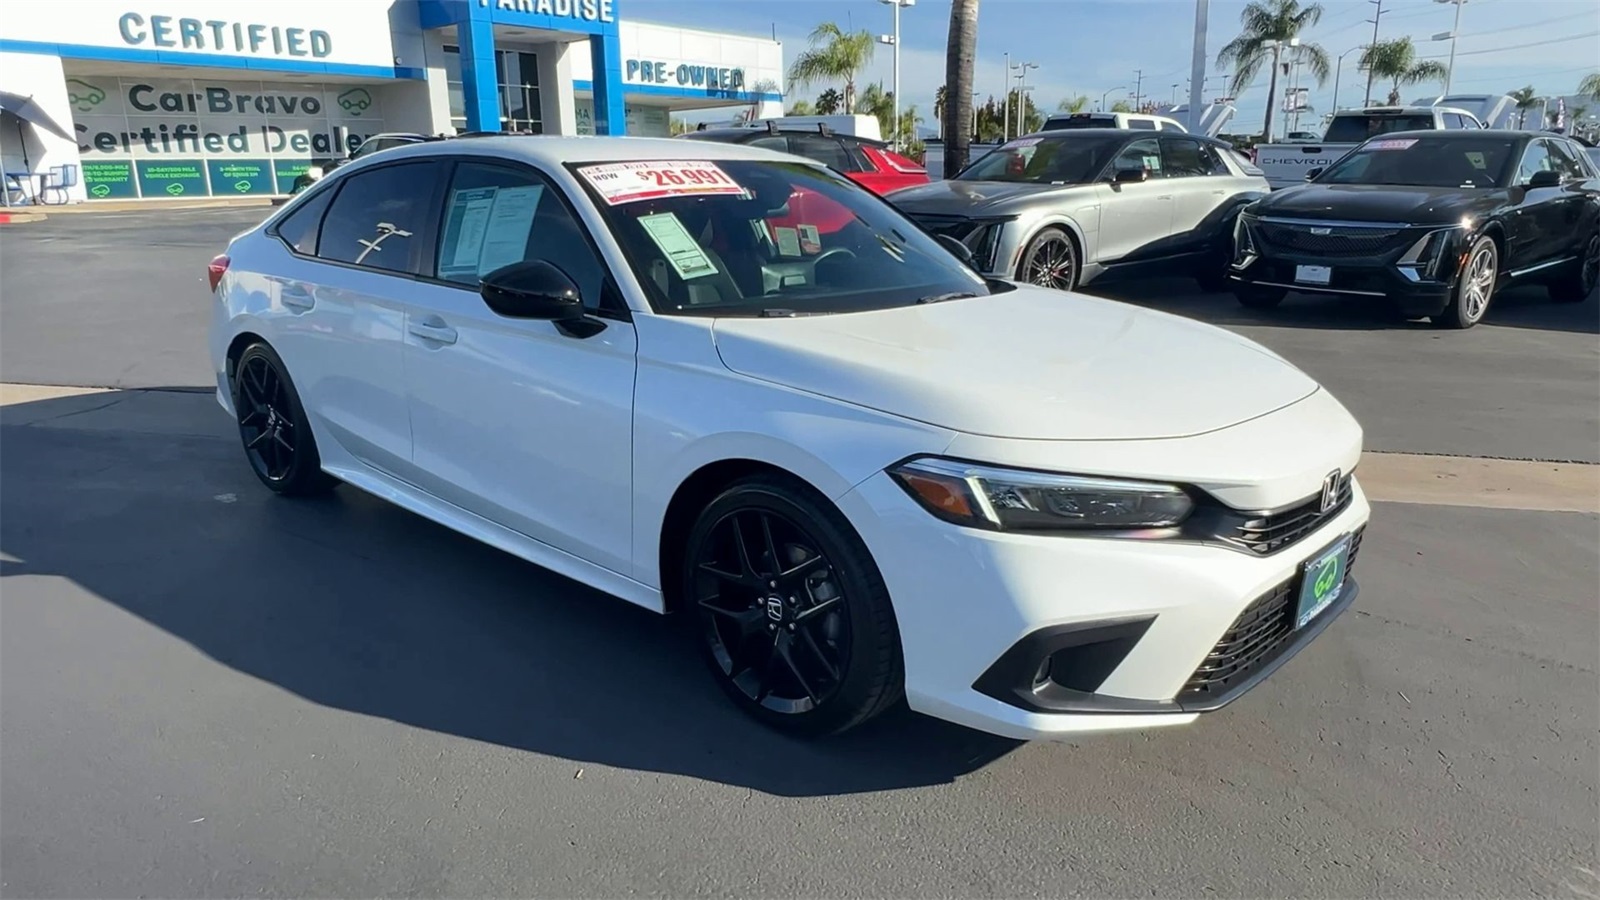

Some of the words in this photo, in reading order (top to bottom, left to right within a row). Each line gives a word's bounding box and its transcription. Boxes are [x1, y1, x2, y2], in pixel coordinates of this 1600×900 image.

[478, 0, 614, 23] RADISE
[119, 12, 333, 58] CERTIFIED
[626, 59, 744, 88] PRE-OWNED
[128, 84, 321, 115] CarBravo
[75, 123, 249, 154] Certified
[592, 173, 618, 181] NOW
